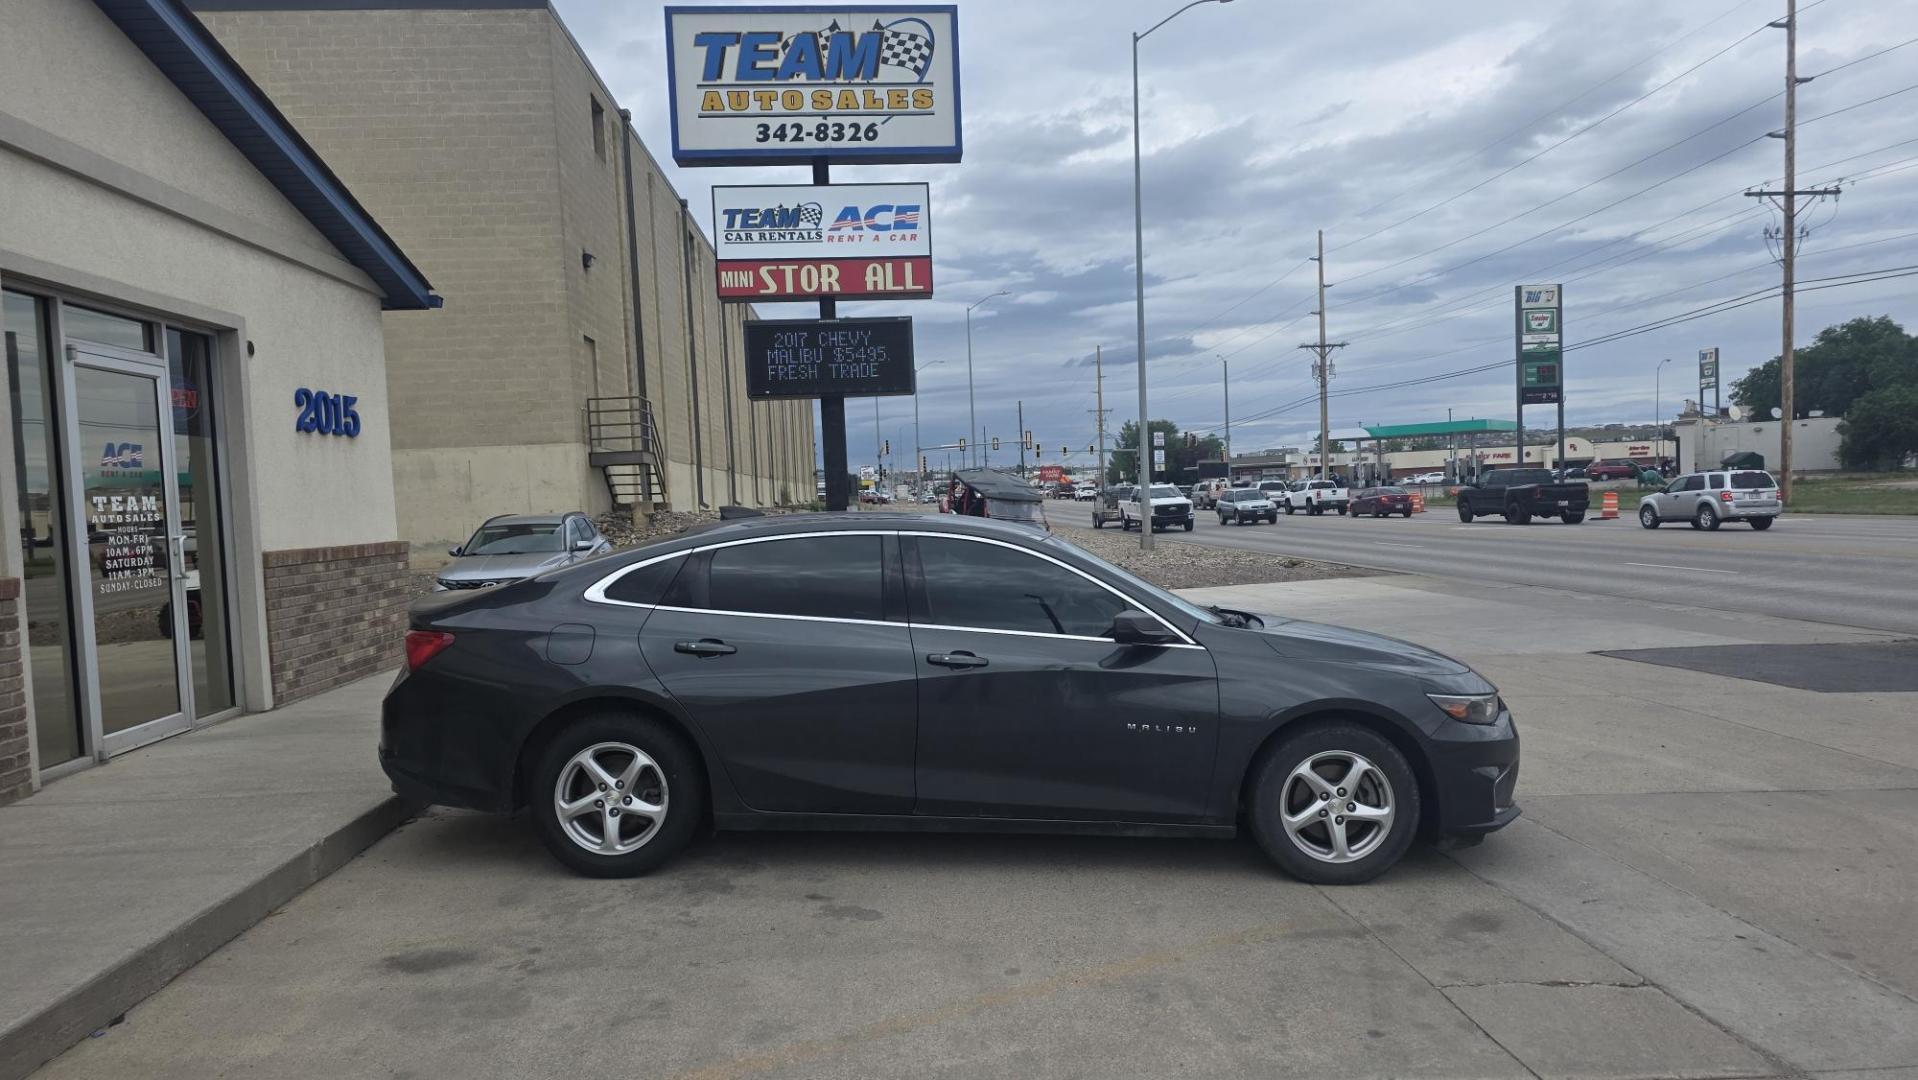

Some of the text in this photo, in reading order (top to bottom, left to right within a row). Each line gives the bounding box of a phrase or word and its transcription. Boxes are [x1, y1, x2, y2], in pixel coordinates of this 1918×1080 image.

[694, 31, 884, 82] TEAM
[701, 89, 934, 111] AUTO SALES
[756, 122, 879, 143] 342-8326
[723, 207, 801, 229] TEAM
[828, 204, 920, 231] ACE
[724, 231, 823, 242] CAR RENTALS
[827, 233, 917, 243] RENT A CAR
[721, 262, 924, 294] MINI STOR ALL
[774, 330, 872, 348] 2017 CHEVY
[768, 348, 823, 364] MALIBU
[768, 362, 879, 381] FRESH TRADE
[294, 388, 360, 438] 2015
[101, 442, 143, 468] ACE
[92, 496, 157, 512] TEAM
[92, 513, 160, 523] AUTO SALES
[105, 556, 154, 569] SATURDAY
[1127, 723, 1196, 733] MALIBU
